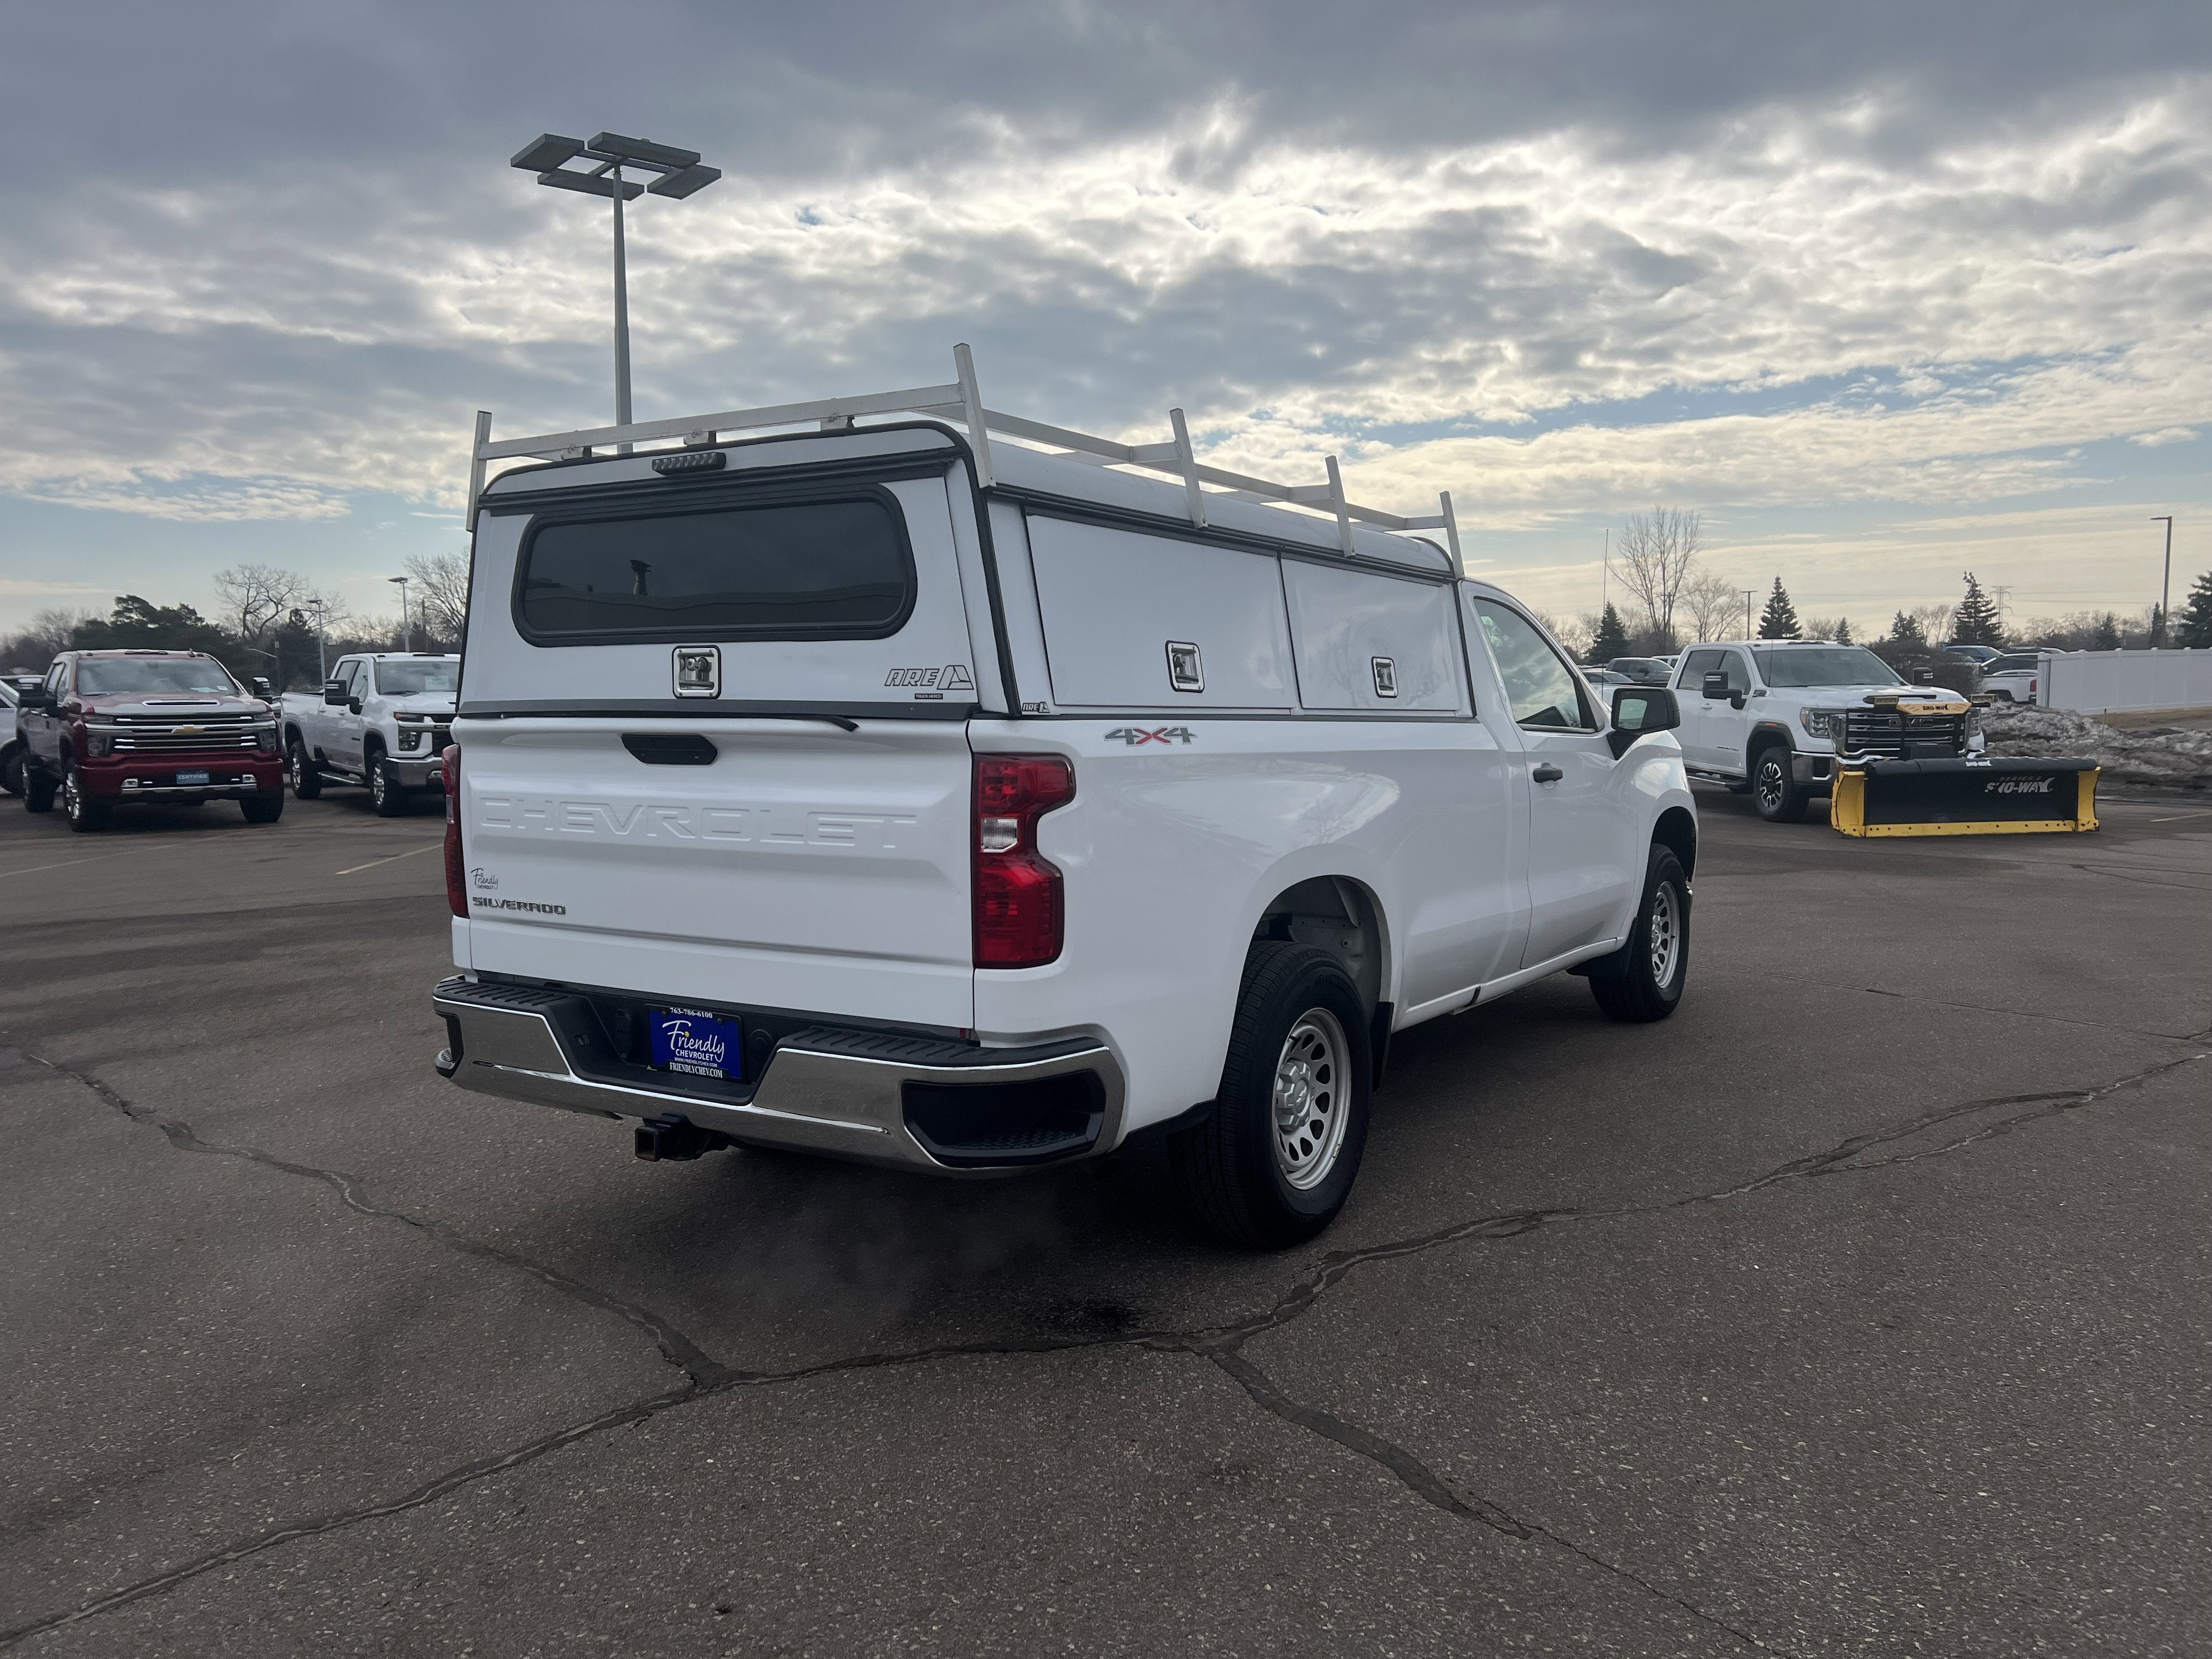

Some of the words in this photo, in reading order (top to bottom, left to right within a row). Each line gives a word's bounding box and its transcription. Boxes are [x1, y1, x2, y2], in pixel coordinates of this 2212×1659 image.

[480, 797, 917, 849] CHEVROLET
[471, 868, 499, 890] Friendly
[472, 896, 566, 915] SILVERADO
[670, 1007, 713, 1018] 763-786-6100
[662, 1020, 724, 1063] Friendly
[675, 1048, 714, 1061] CHEVROLET
[669, 1062, 723, 1079] FRIENDLYCHEV.COM
